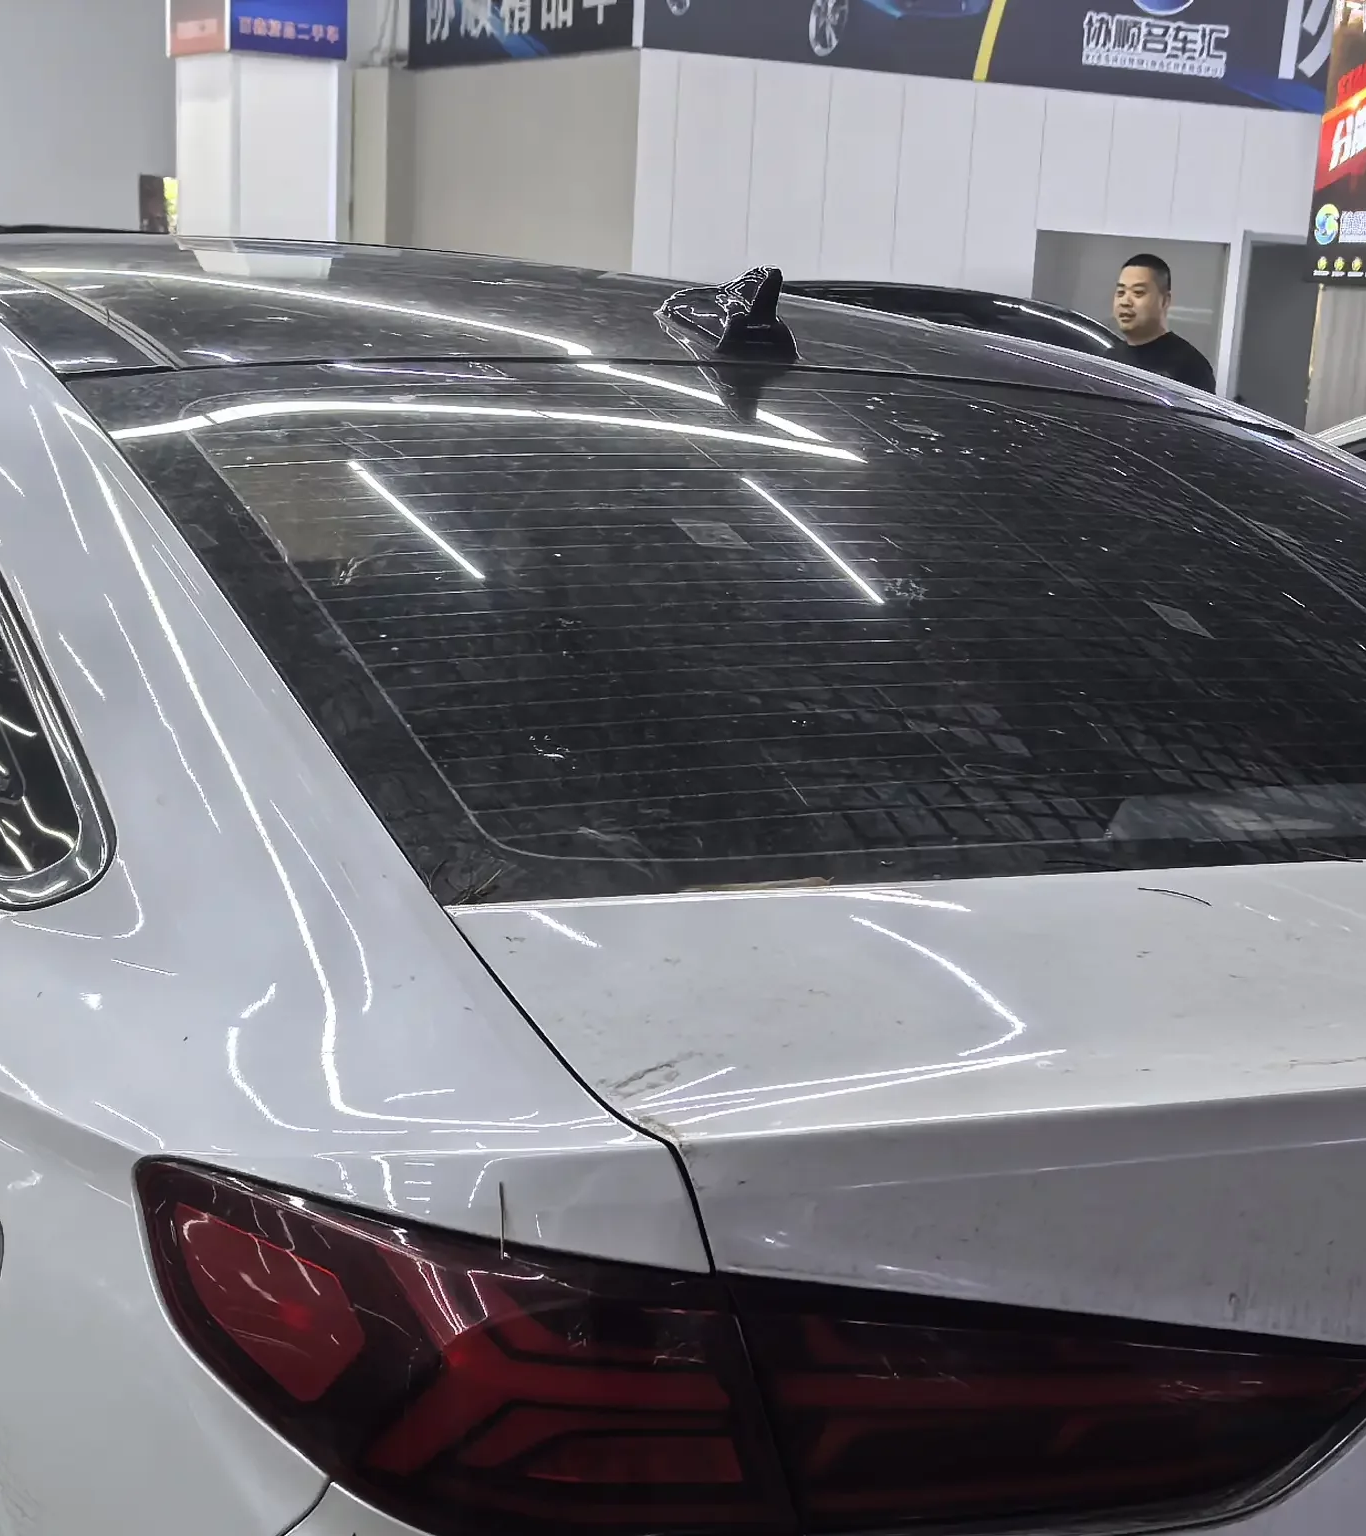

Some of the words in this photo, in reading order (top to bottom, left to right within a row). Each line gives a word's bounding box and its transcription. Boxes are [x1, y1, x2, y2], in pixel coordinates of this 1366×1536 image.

[1083, 12, 1229, 62] 协顺名车汇
